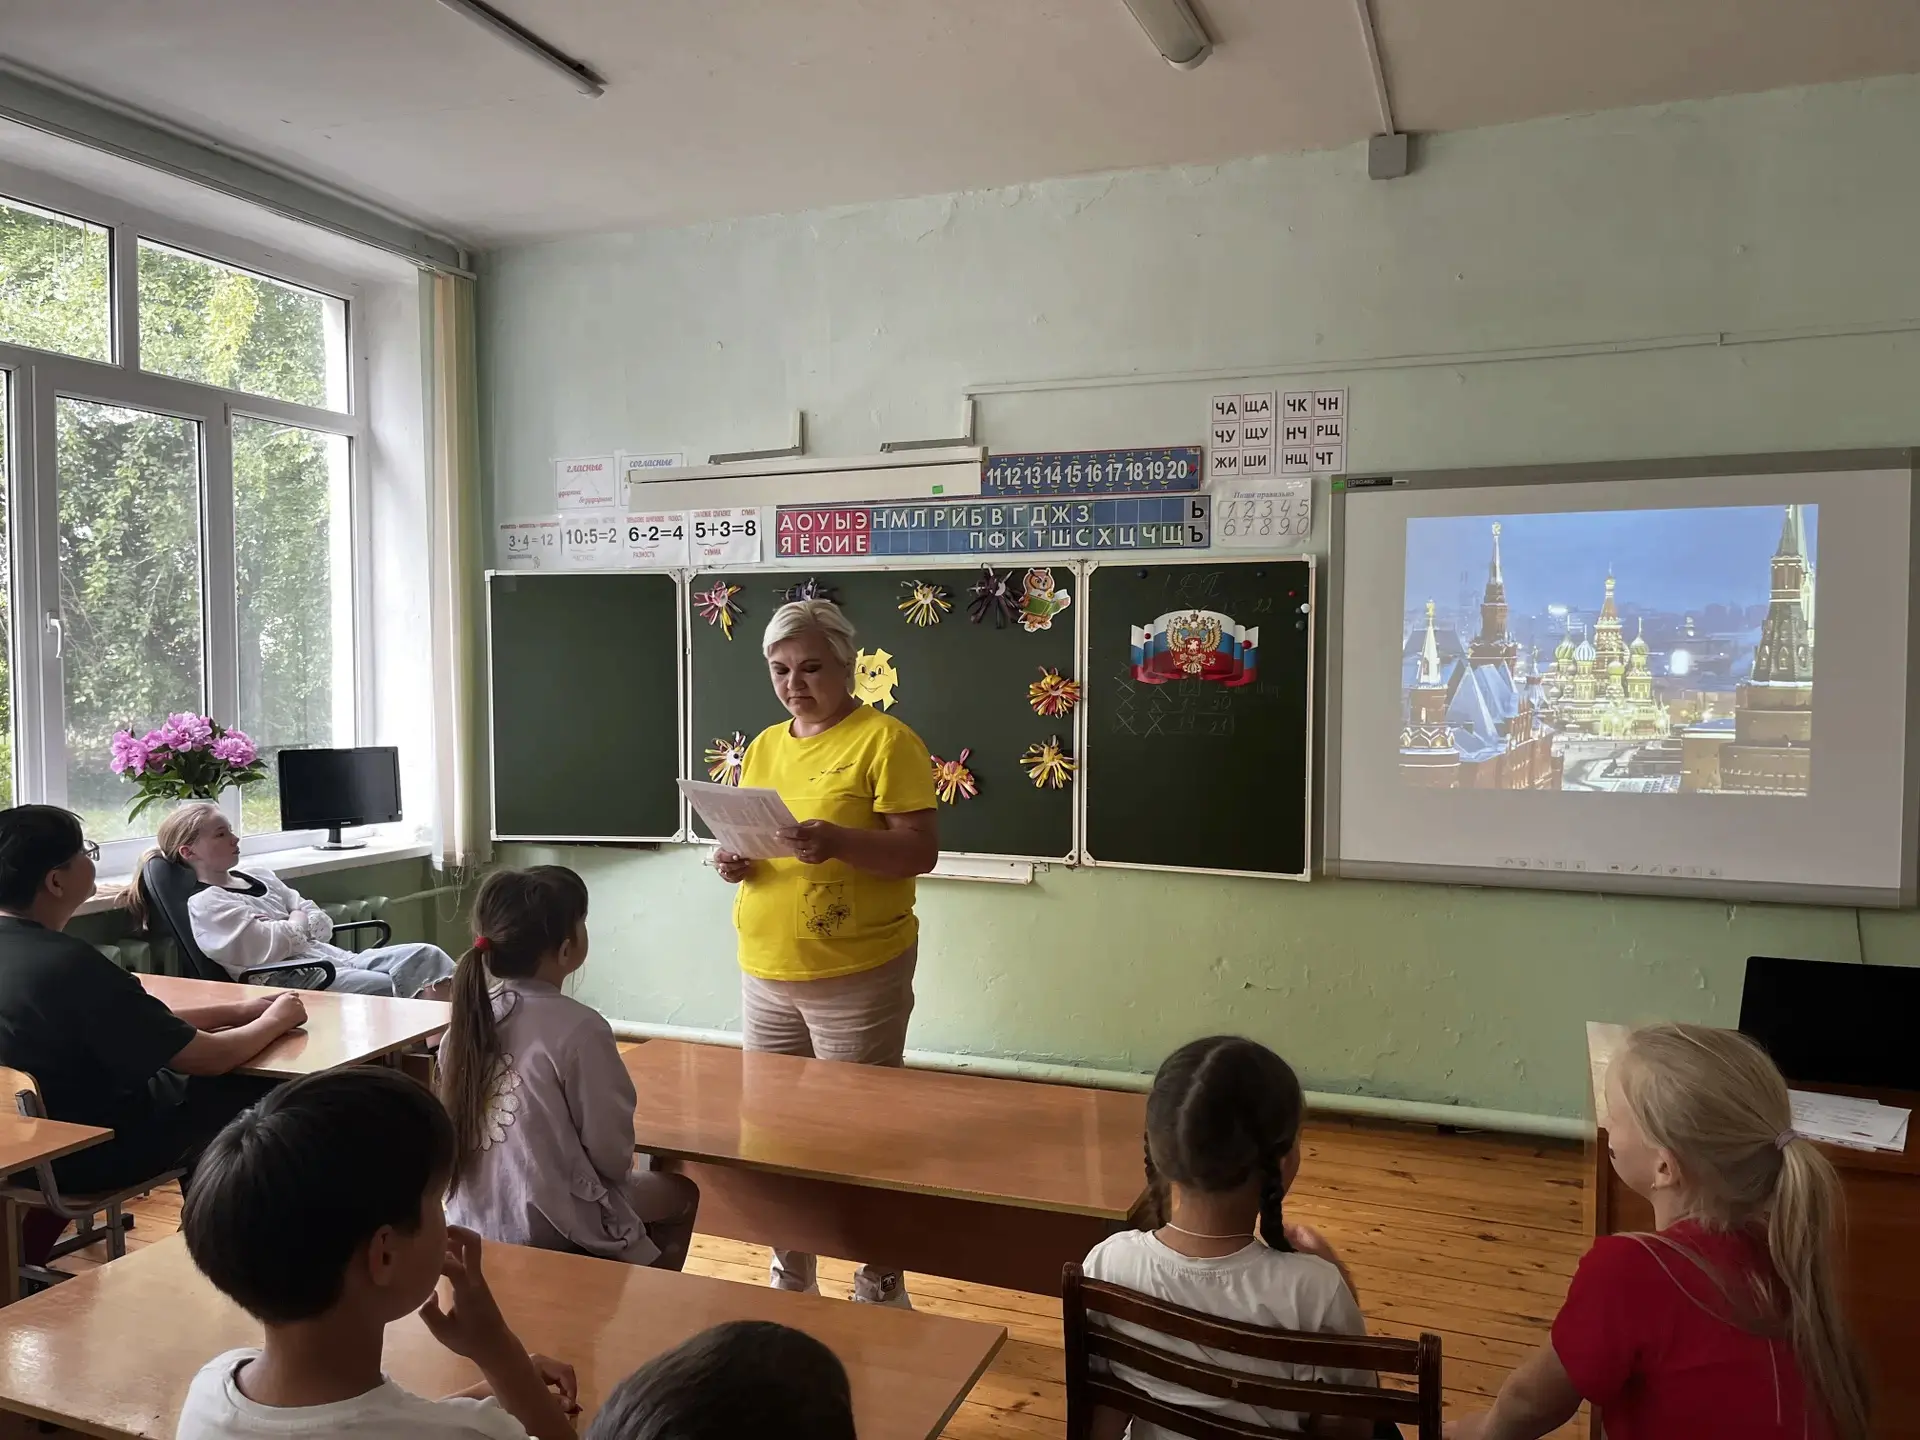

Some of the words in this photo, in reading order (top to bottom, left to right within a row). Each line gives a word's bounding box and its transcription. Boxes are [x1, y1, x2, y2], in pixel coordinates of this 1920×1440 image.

[1216, 402, 1237, 415] ЧА
[1245, 400, 1269, 413] ЩА
[1287, 399, 1308, 412] ЧК
[1317, 398, 1339, 410] ЧН
[1215, 430, 1236, 443] ЧУ
[1245, 427, 1268, 440] ЩУ
[1286, 427, 1307, 440] НЧ
[1317, 425, 1340, 437] РЩ
[630, 459, 673, 468] согласные
[1215, 456, 1237, 469] ЖИ
[1244, 455, 1267, 467] ШИ
[1285, 454, 1308, 466] НЩ
[1316, 452, 1334, 465] ЧТ
[567, 464, 603, 473] гласные
[987, 468, 1000, 486] 11
[1005, 468, 1020, 485] 12
[1024, 467, 1040, 485] 13
[1044, 466, 1061, 484] 14
[1065, 465, 1082, 483] 15
[1085, 464, 1102, 482] 16
[1106, 464, 1123, 482] 17
[1126, 462, 1143, 481] 18
[1146, 462, 1164, 480] 19
[1167, 460, 1187, 479] 20
[1227, 501, 1237, 518] 1
[1243, 501, 1255, 518] 2
[1261, 500, 1273, 518] 3
[1280, 500, 1291, 518] 4
[1297, 499, 1309, 517] 5
[1224, 518, 1236, 536] 6
[1242, 519, 1253, 536] 7
[1259, 518, 1272, 536] 8
[1278, 518, 1290, 536] 9
[1297, 518, 1309, 536] 0
